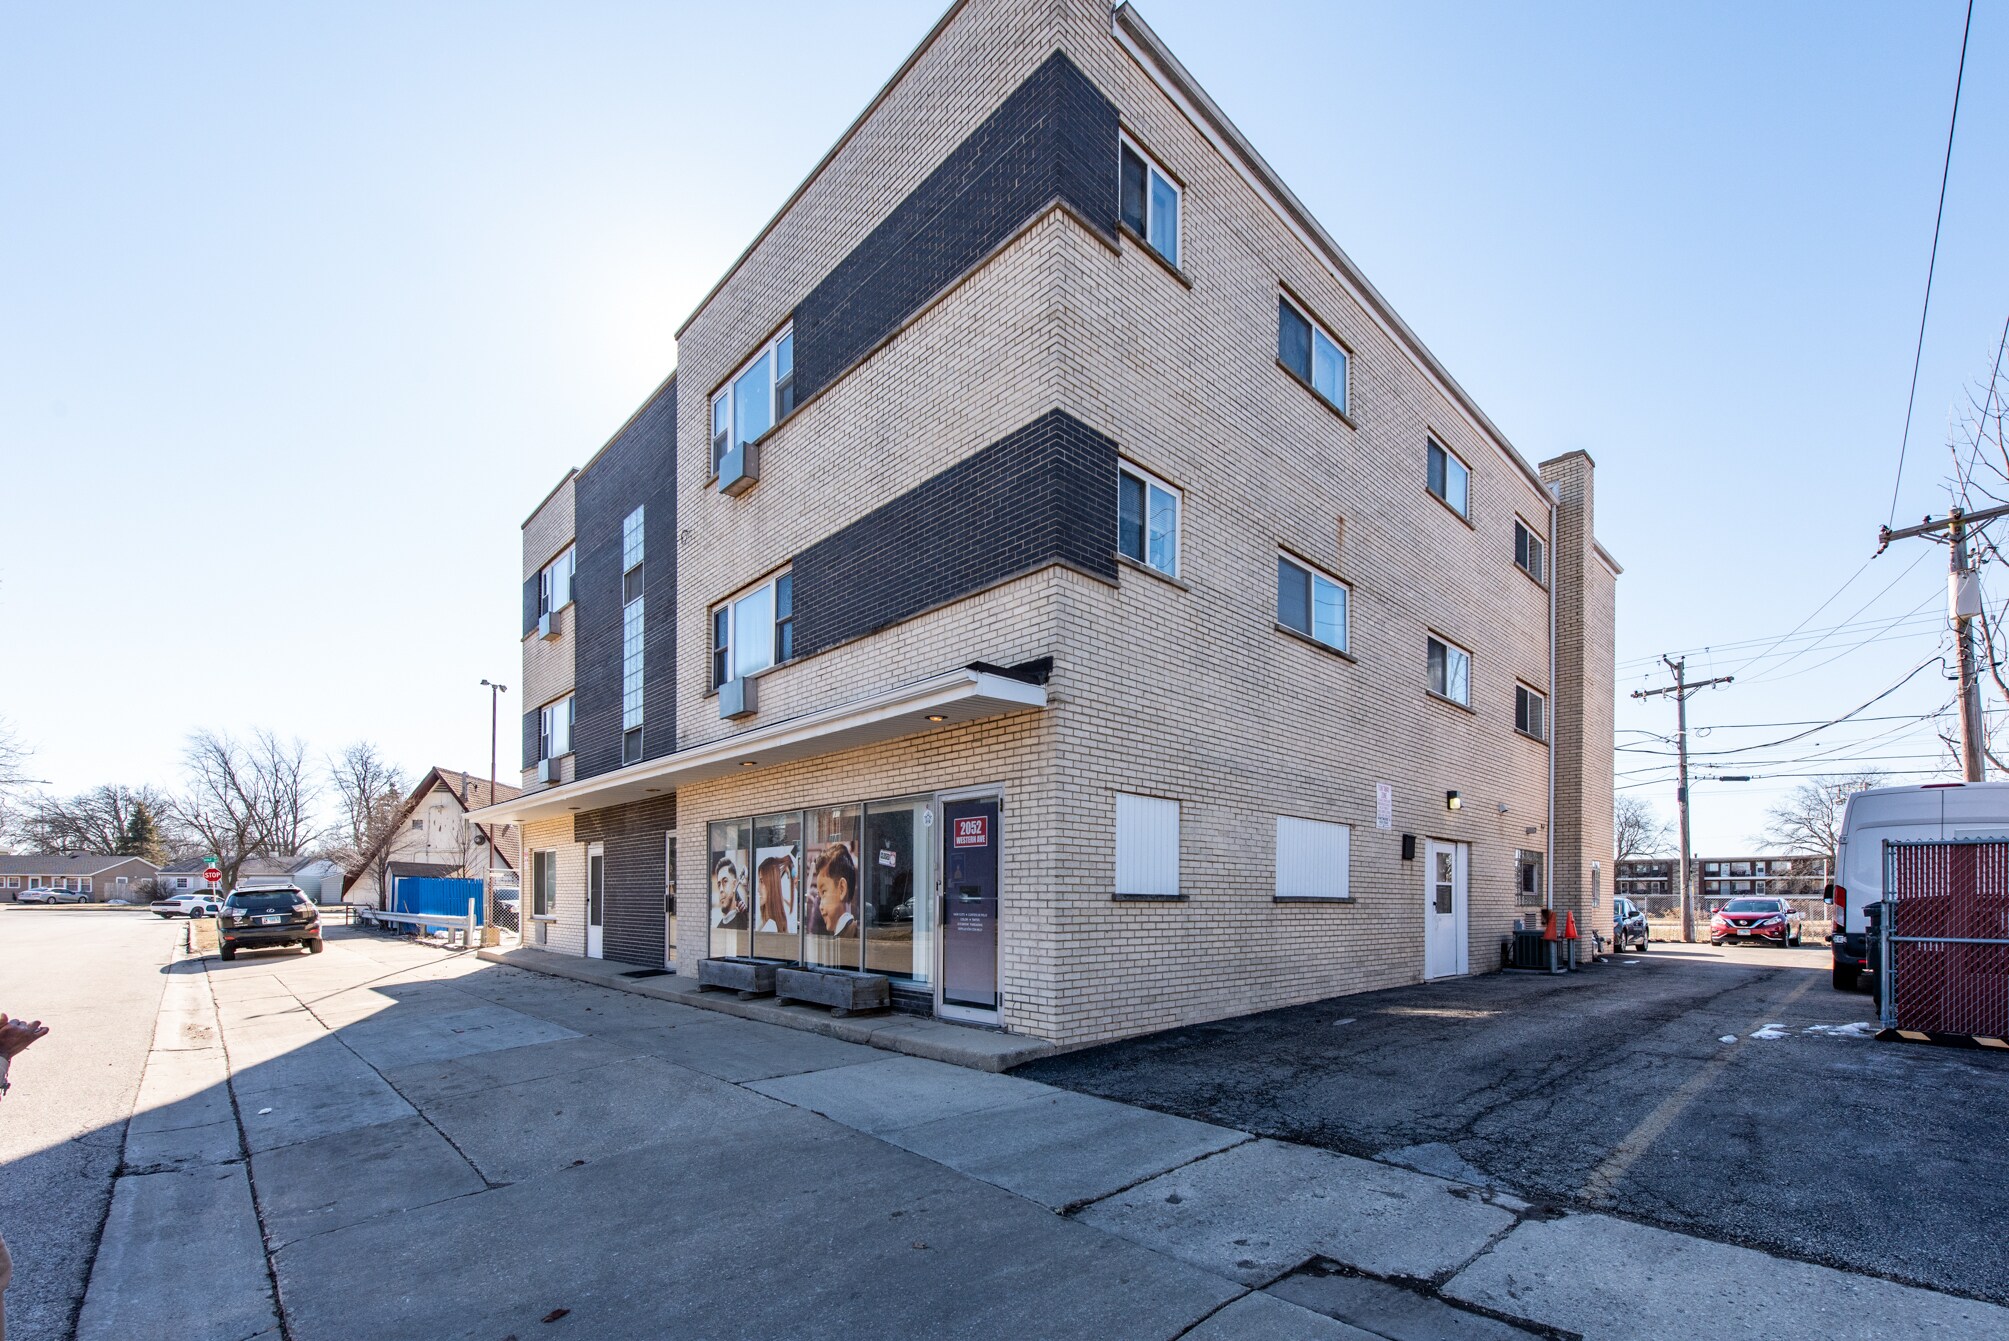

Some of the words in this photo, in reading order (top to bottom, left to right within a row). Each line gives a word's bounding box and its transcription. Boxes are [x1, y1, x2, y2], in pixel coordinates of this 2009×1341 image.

[960, 820, 982, 835] 2052
[956, 835, 976, 844] WESTERN
[976, 835, 986, 843] AVE
[204, 871, 221, 879] STOP
